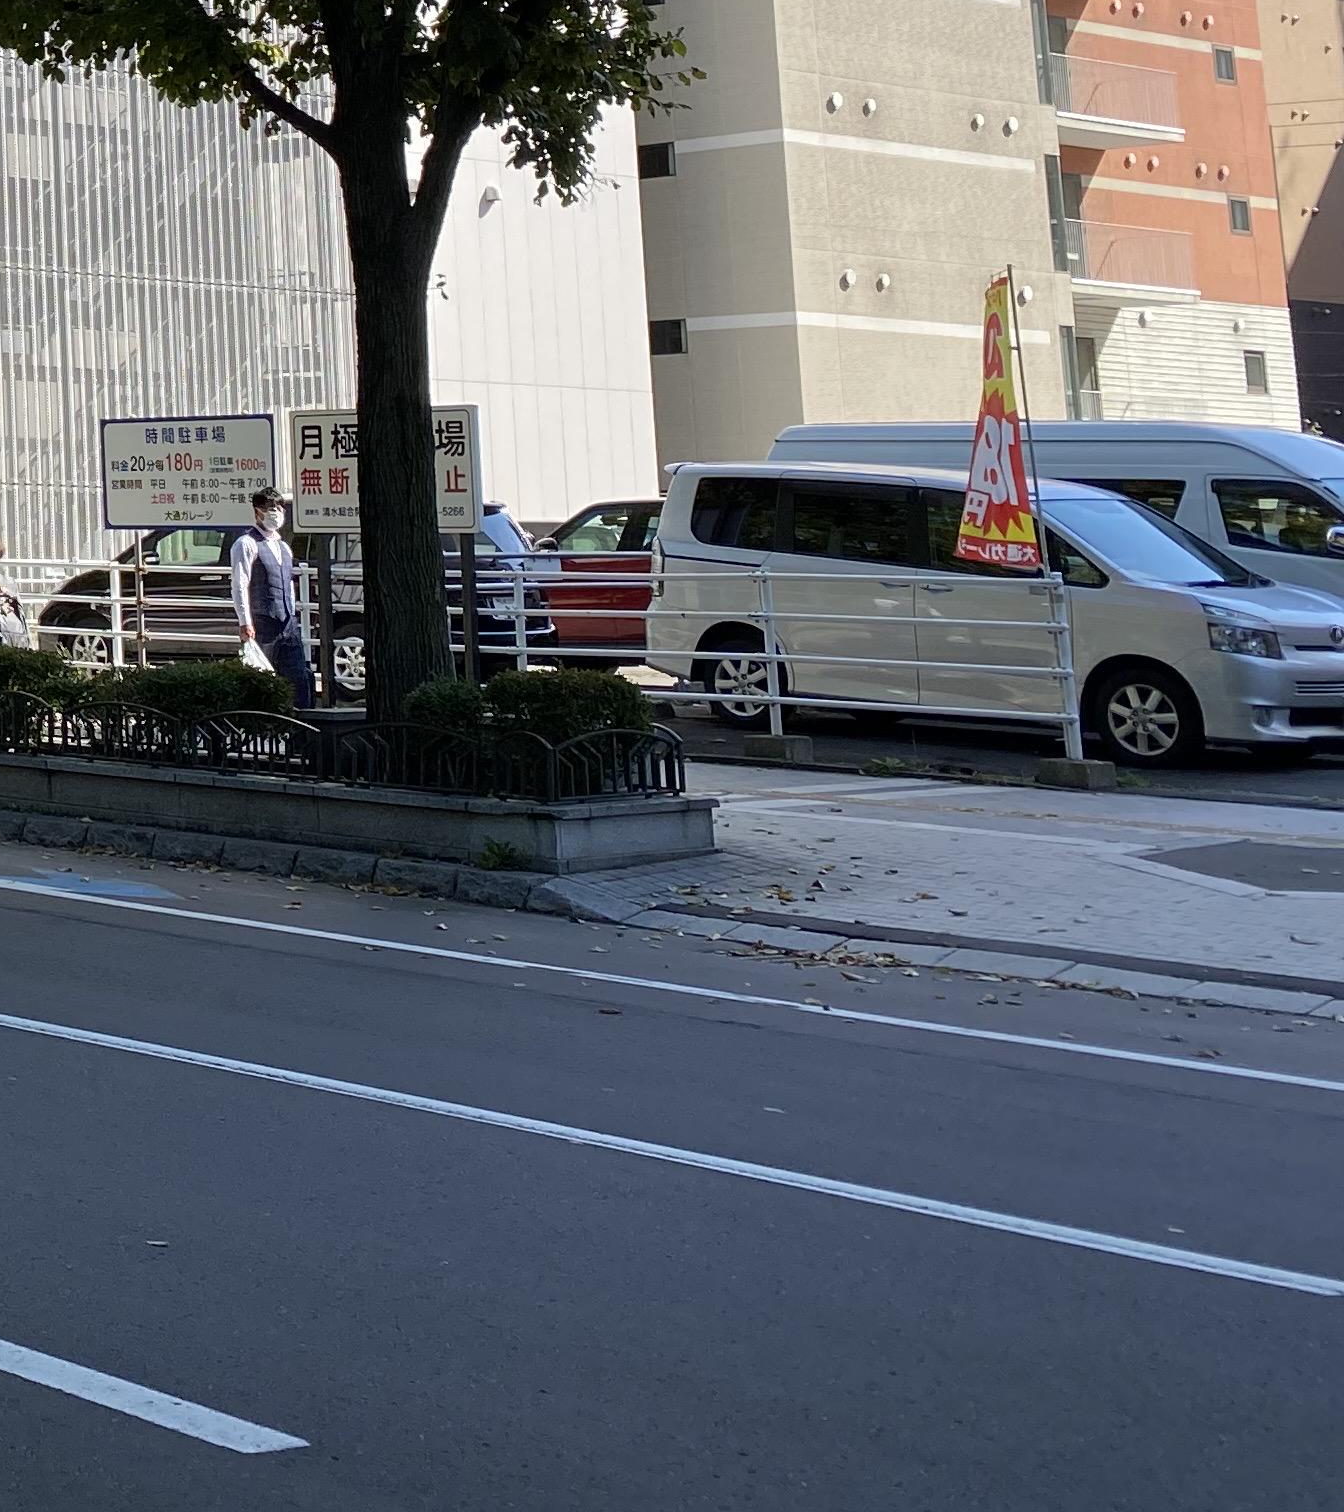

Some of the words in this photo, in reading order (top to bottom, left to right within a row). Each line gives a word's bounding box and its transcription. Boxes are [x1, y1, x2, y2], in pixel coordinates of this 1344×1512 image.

[145, 426, 226, 444] 時間駐車場
[299, 420, 466, 459] 月極場
[150, 479, 166, 489] 平日
[300, 465, 468, 495] 無断止
[151, 493, 175, 504] 土日祝
